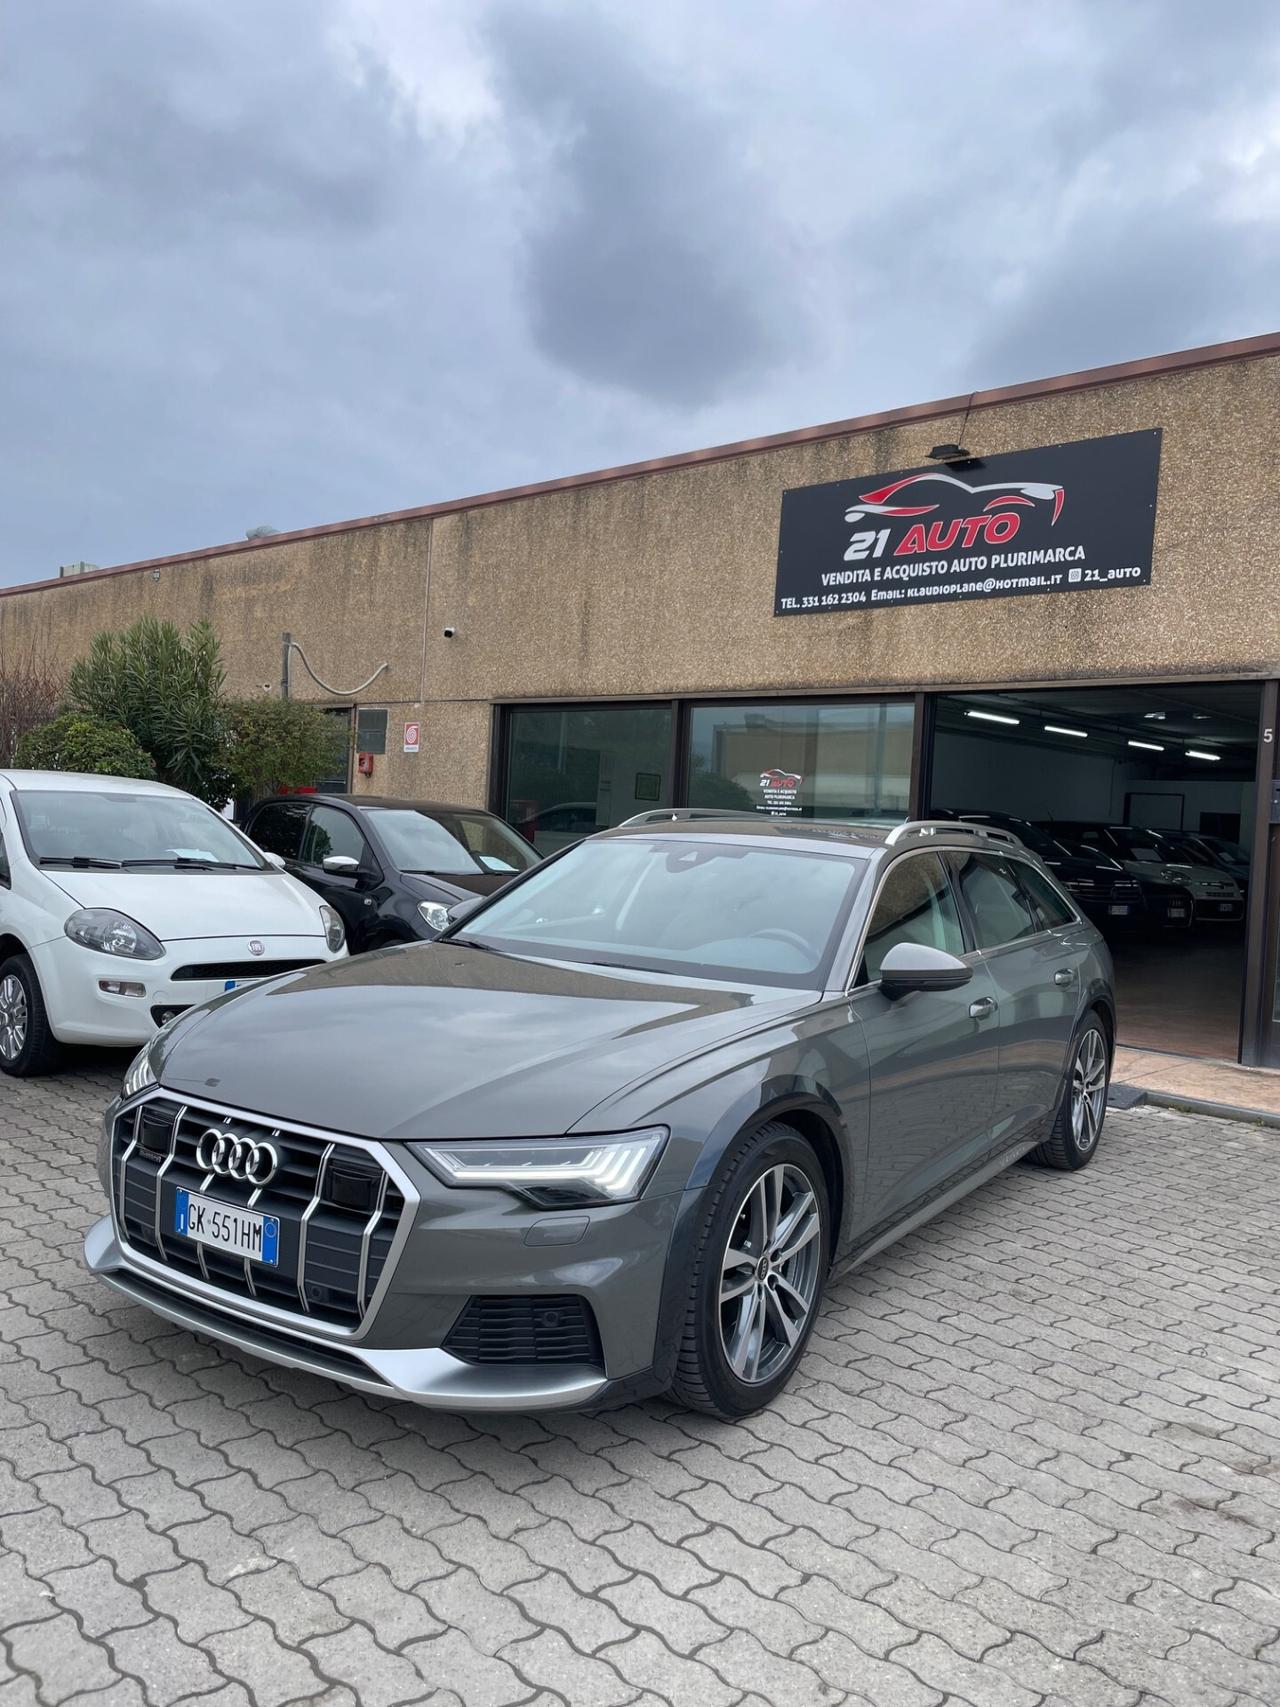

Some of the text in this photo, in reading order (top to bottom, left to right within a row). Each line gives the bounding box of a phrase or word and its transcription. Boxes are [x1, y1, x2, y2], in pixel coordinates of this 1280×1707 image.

[843, 512, 1021, 561] 21 AUTO
[821, 545, 1085, 586] VENDITA E ACQUISTO AUTO PLURIMARCA
[781, 597, 800, 609] TEL.
[801, 595, 820, 608] 331
[821, 594, 838, 606] 162
[840, 591, 866, 605] 2304
[1263, 728, 1273, 743] 5
[759, 779, 770, 787] 21
